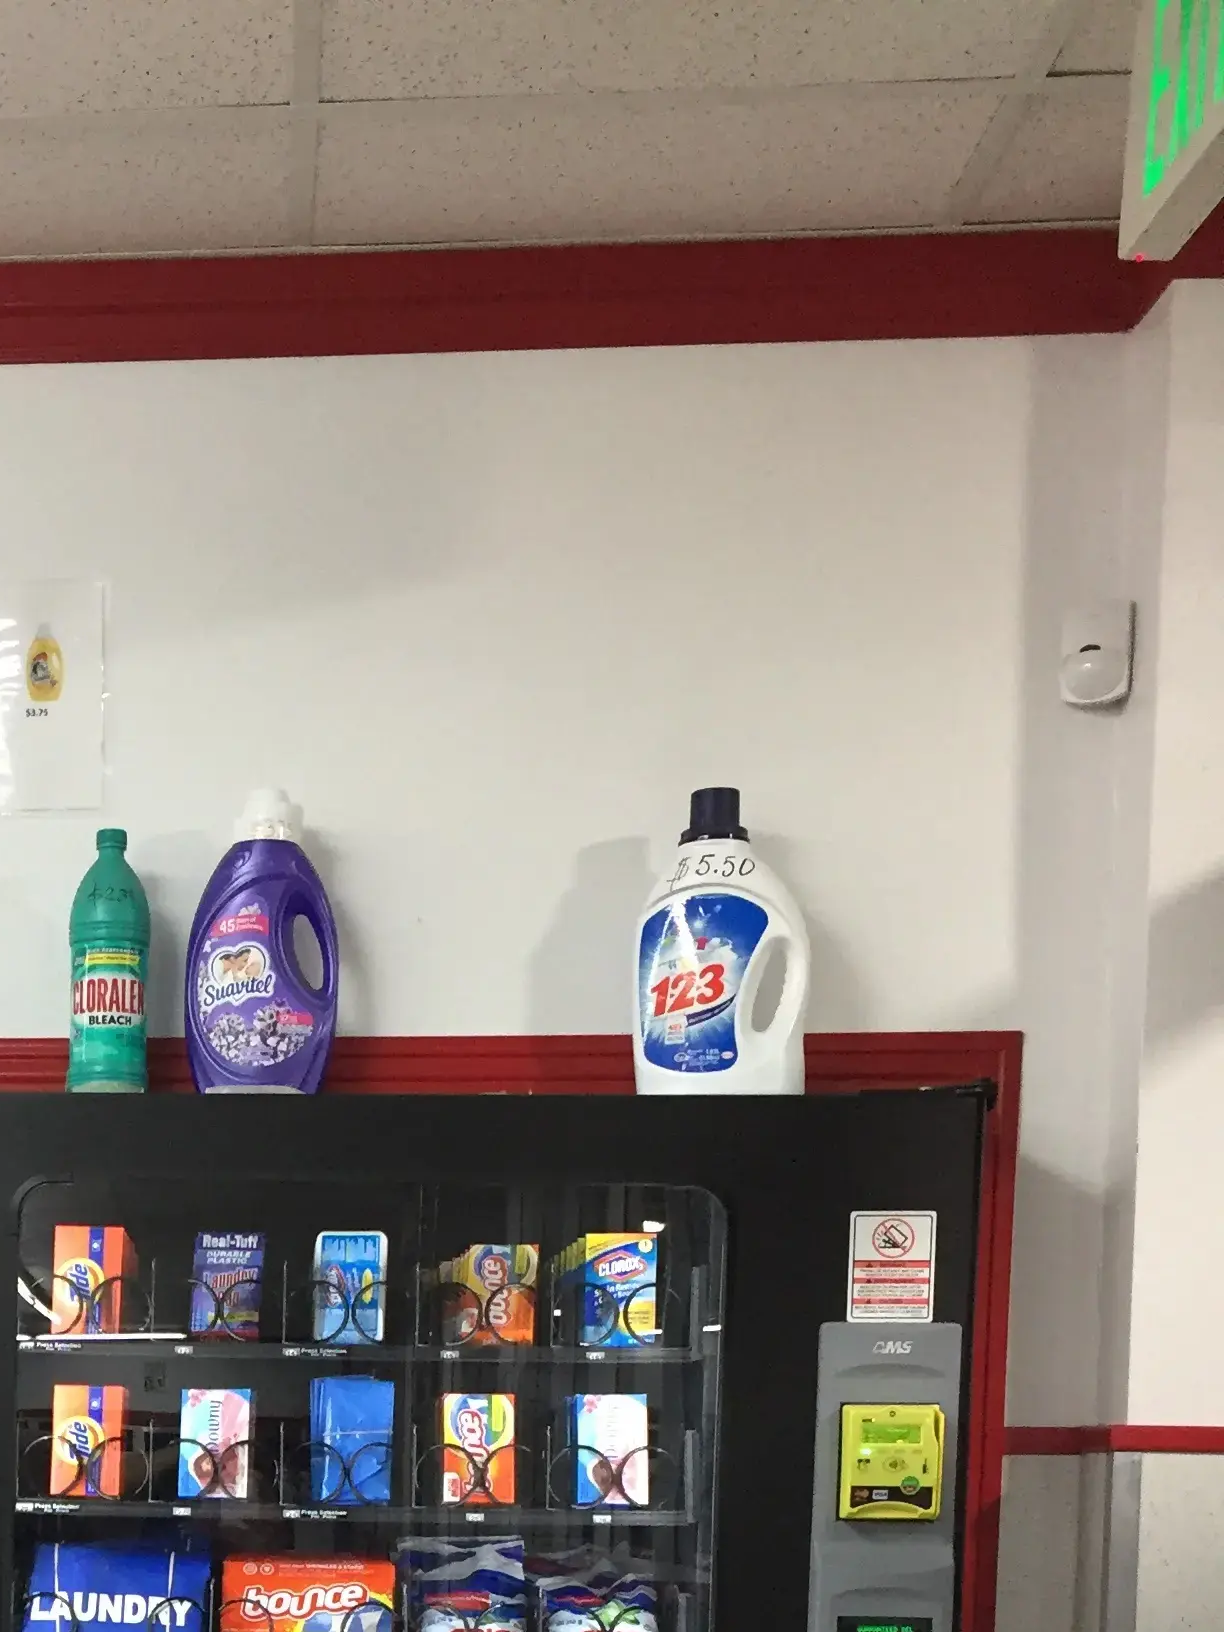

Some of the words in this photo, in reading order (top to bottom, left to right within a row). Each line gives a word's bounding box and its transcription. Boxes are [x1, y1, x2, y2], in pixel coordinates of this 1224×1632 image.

[25, 708, 49, 718] $3.75
[219, 919, 236, 934] 45
[73, 978, 145, 1015] CLORALEN
[204, 974, 273, 1007] Suavitel
[650, 963, 725, 1017] 123
[88, 1015, 132, 1025] BLEACH
[202, 1234, 259, 1249] Real-Tuff
[206, 1257, 249, 1265] PLASTIC
[598, 1256, 644, 1277] CLOROX
[487, 1257, 504, 1327] ounce
[872, 1339, 914, 1354] AMS
[207, 1400, 224, 1454] Downy
[30, 1591, 192, 1627] LAUNDRY
[244, 1584, 364, 1618] bounce
